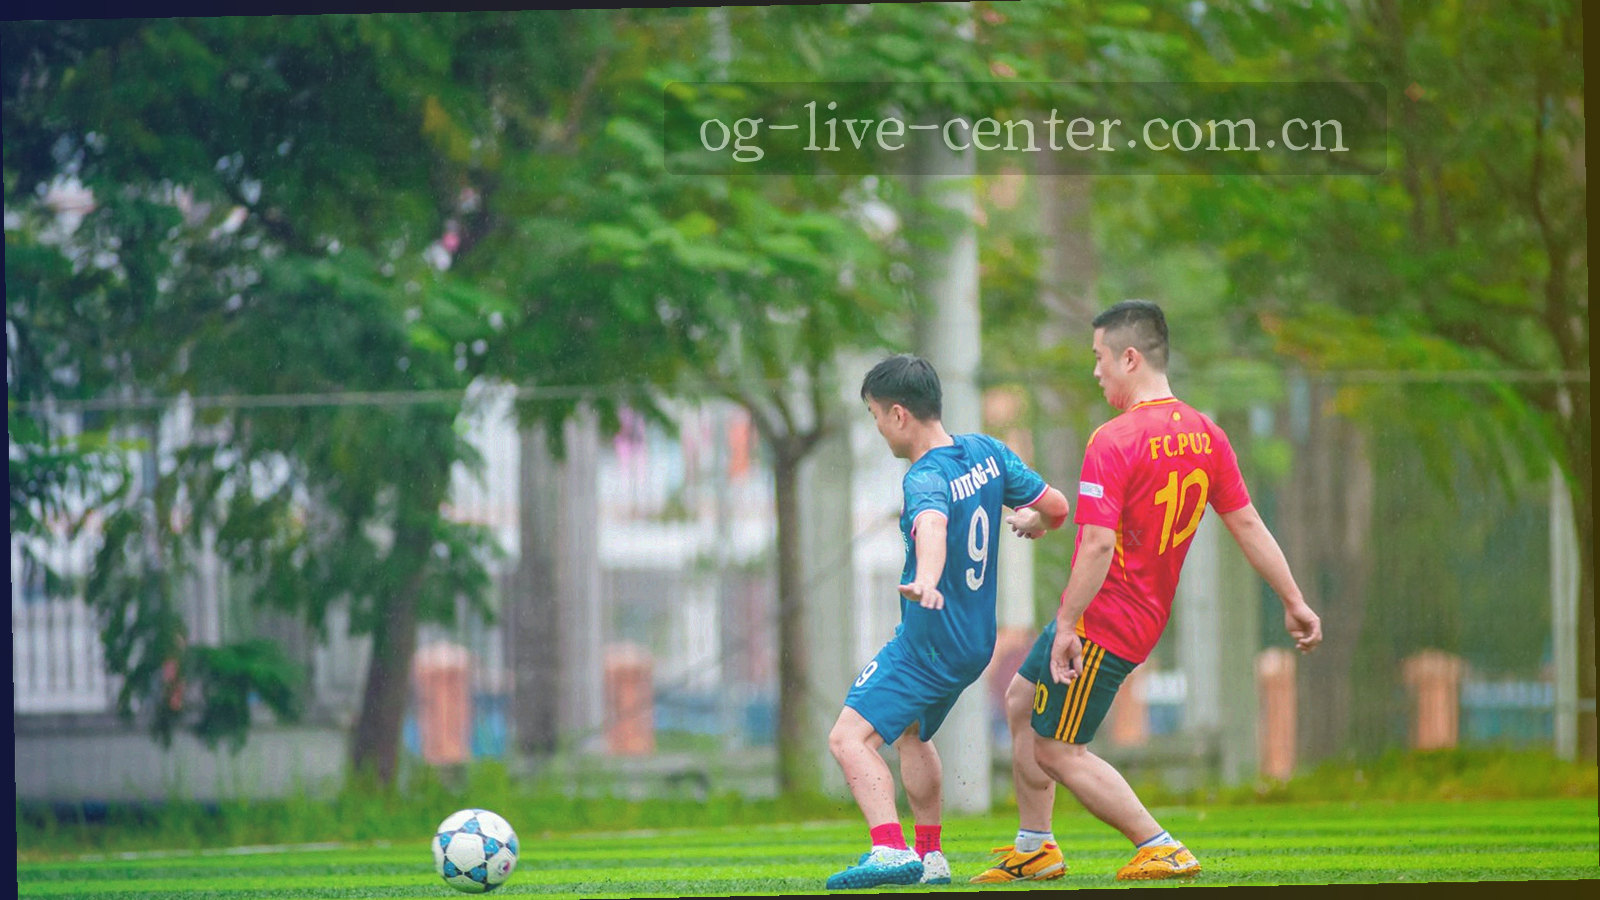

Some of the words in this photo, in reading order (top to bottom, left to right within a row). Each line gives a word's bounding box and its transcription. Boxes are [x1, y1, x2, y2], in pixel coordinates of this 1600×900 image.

[966, 505, 989, 591] 9
[1154, 468, 1209, 556] 10
[855, 660, 878, 687] 9
